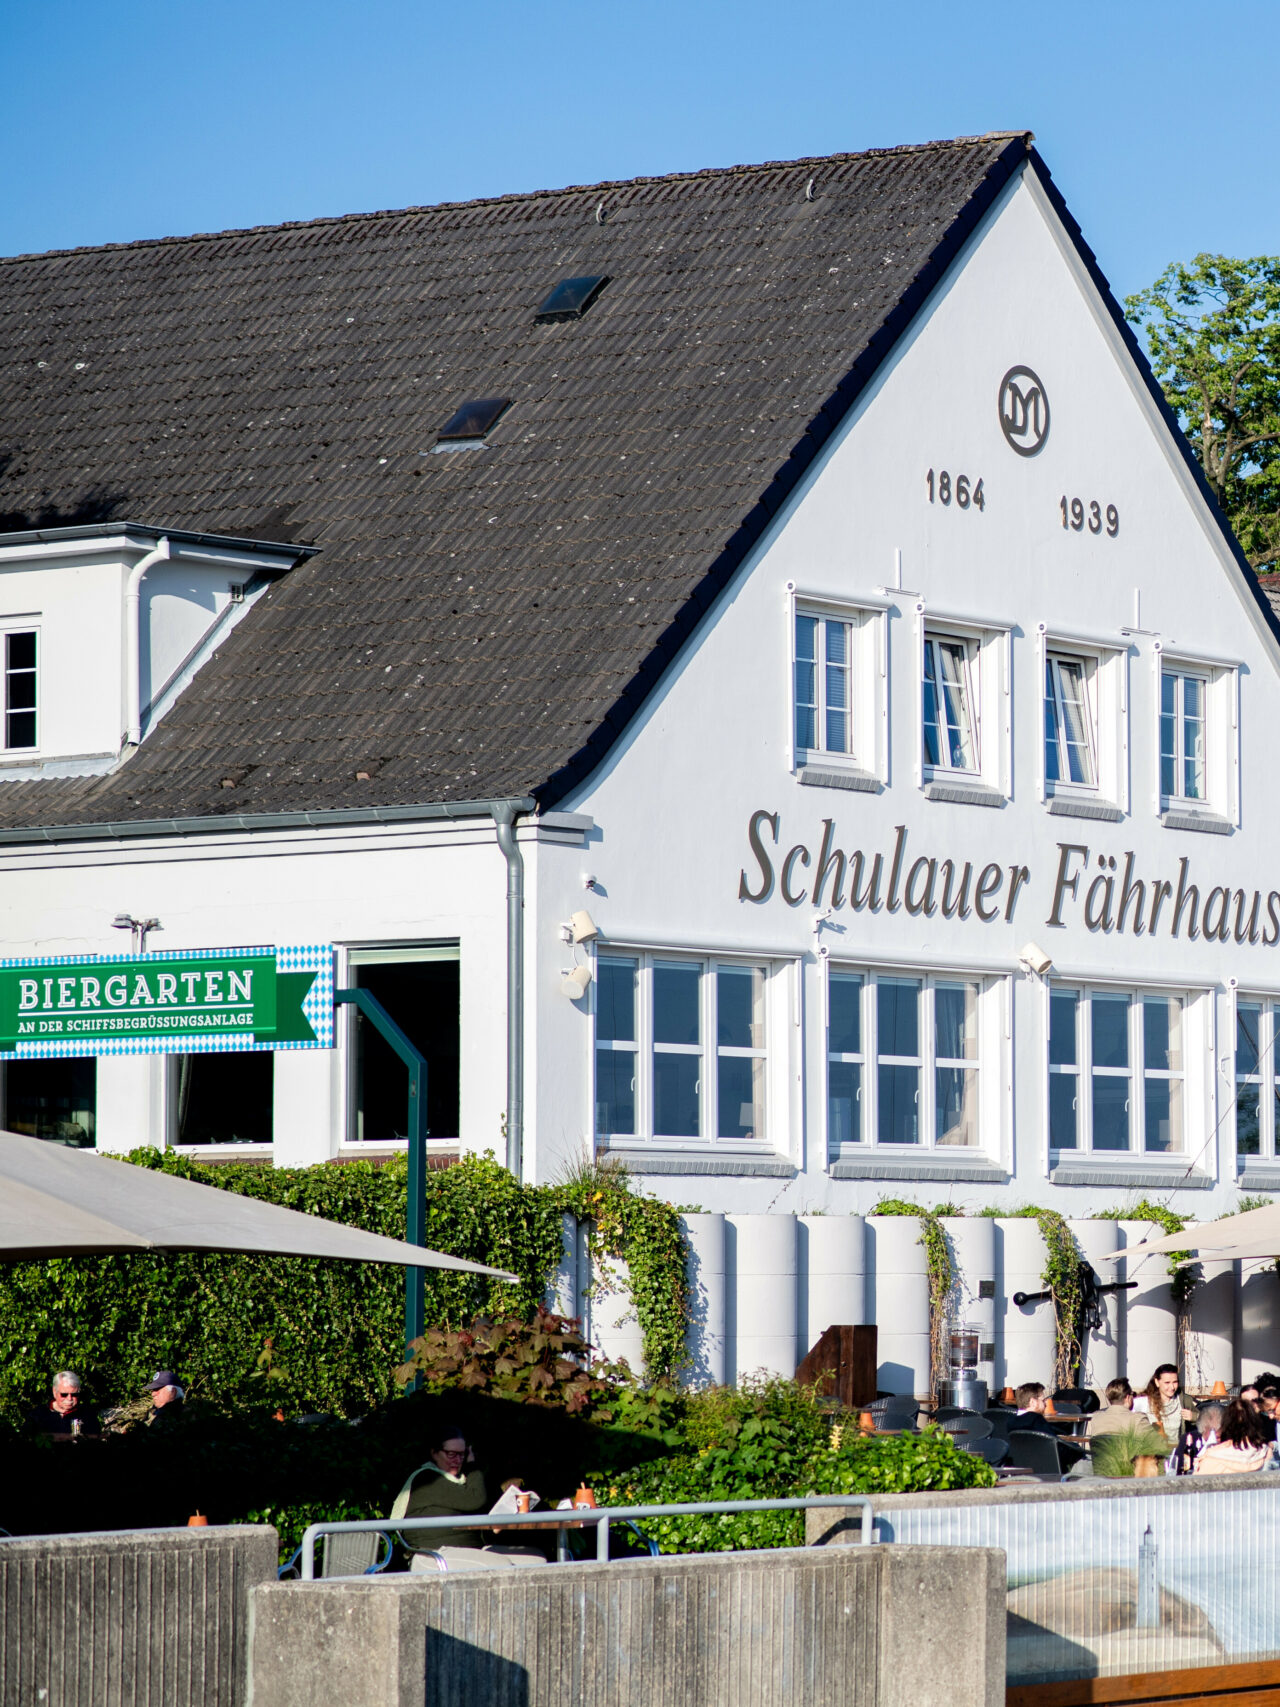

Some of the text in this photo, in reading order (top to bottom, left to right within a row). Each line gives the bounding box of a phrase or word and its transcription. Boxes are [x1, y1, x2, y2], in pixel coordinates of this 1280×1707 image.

[926, 468, 985, 512] 1864
[1060, 495, 1119, 538] 1939
[738, 809, 1030, 922] Schulauer
[19, 970, 254, 1010] BIERGARTEN
[17, 1013, 254, 1034] AN DER SCHIFFSBEGRÜSSUNGSANLAGE
